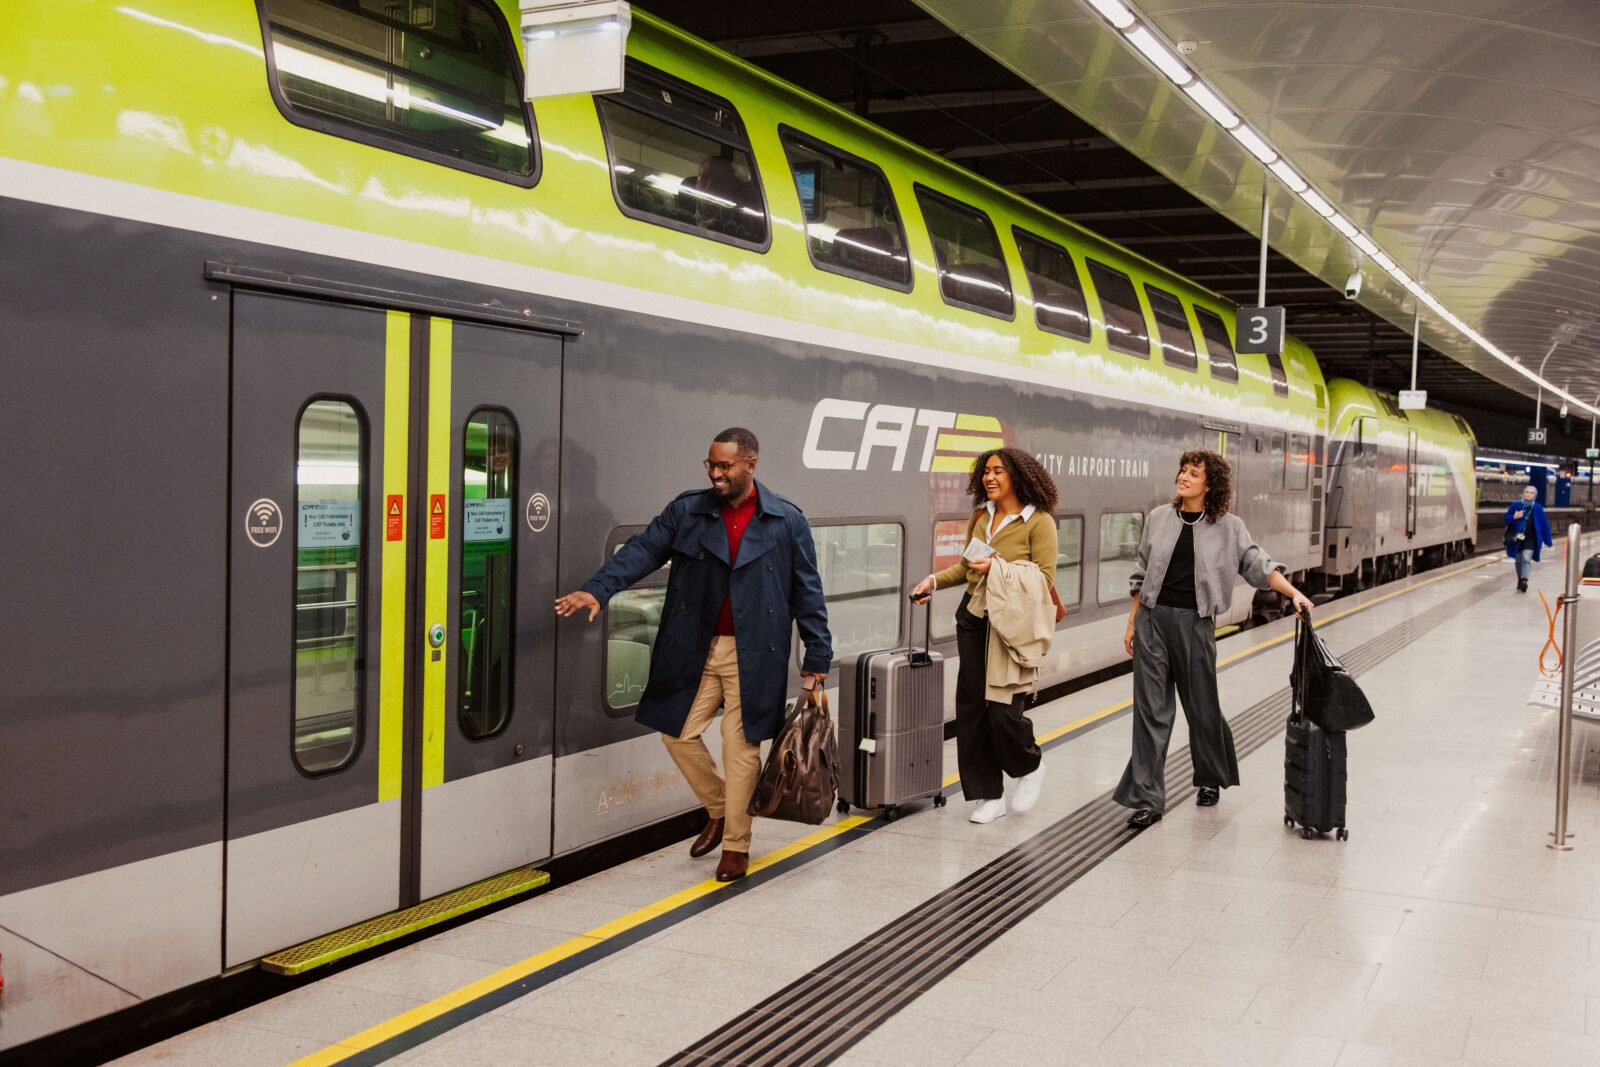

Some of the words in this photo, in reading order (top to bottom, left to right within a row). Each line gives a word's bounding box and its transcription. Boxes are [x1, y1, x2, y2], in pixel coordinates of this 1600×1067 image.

[1248, 316, 1268, 344] 3
[802, 398, 957, 472] CAT
[1528, 431, 1544, 441] 3D
[1068, 455, 1116, 477] AIRPORT
[1120, 459, 1149, 477] TRAIN
